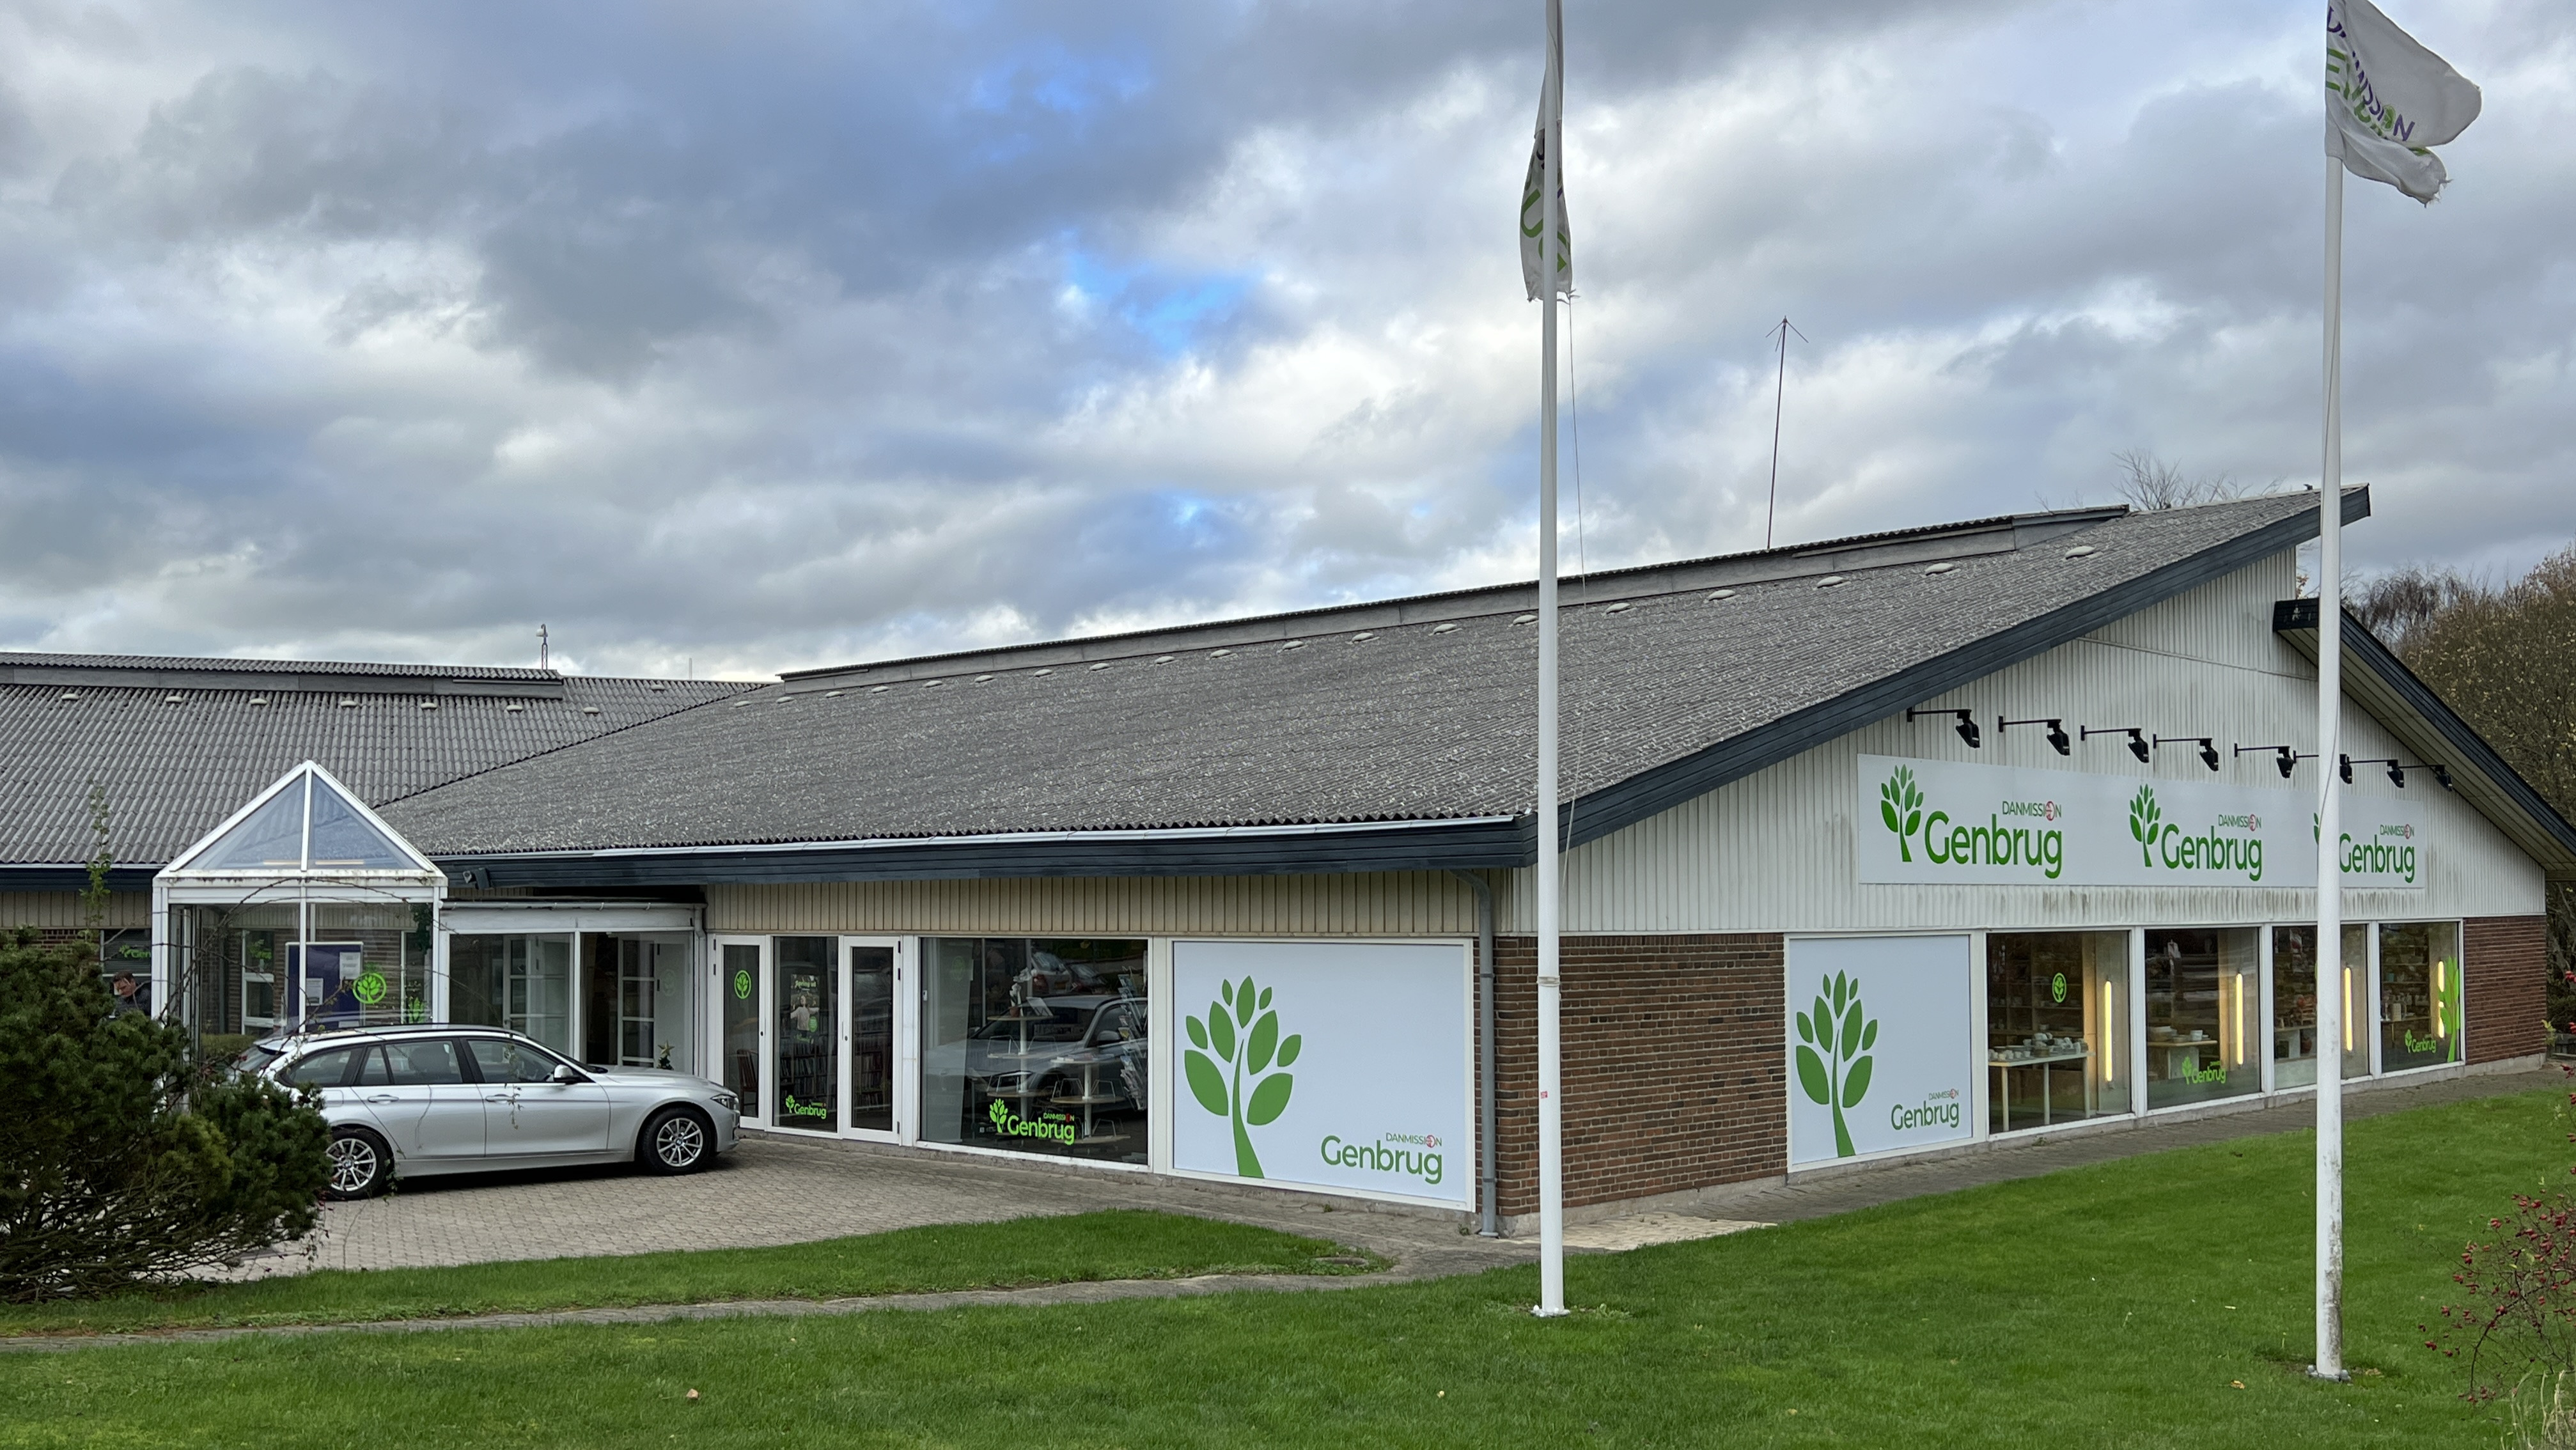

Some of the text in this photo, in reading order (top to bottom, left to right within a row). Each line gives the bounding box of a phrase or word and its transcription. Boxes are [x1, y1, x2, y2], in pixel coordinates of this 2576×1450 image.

[2002, 800, 2062, 822] DANMISSION
[2218, 814, 2262, 832] DANMISSION
[2380, 823, 2415, 839] DANMISSION
[1924, 810, 2063, 880] Genbrug
[2161, 823, 2263, 882] Genbrug
[2339, 832, 2415, 884] Genbrug
[2192, 1065, 2226, 1084] Genbrug
[1928, 1088, 1959, 1100] DANMISSION
[794, 1103, 827, 1119] Genbrug
[1891, 1100, 1959, 1131] Genbrug
[1007, 1115, 1075, 1146] Genbrug
[1386, 1132, 1442, 1148] DANMISSION
[1321, 1135, 1442, 1185] Genbrug
